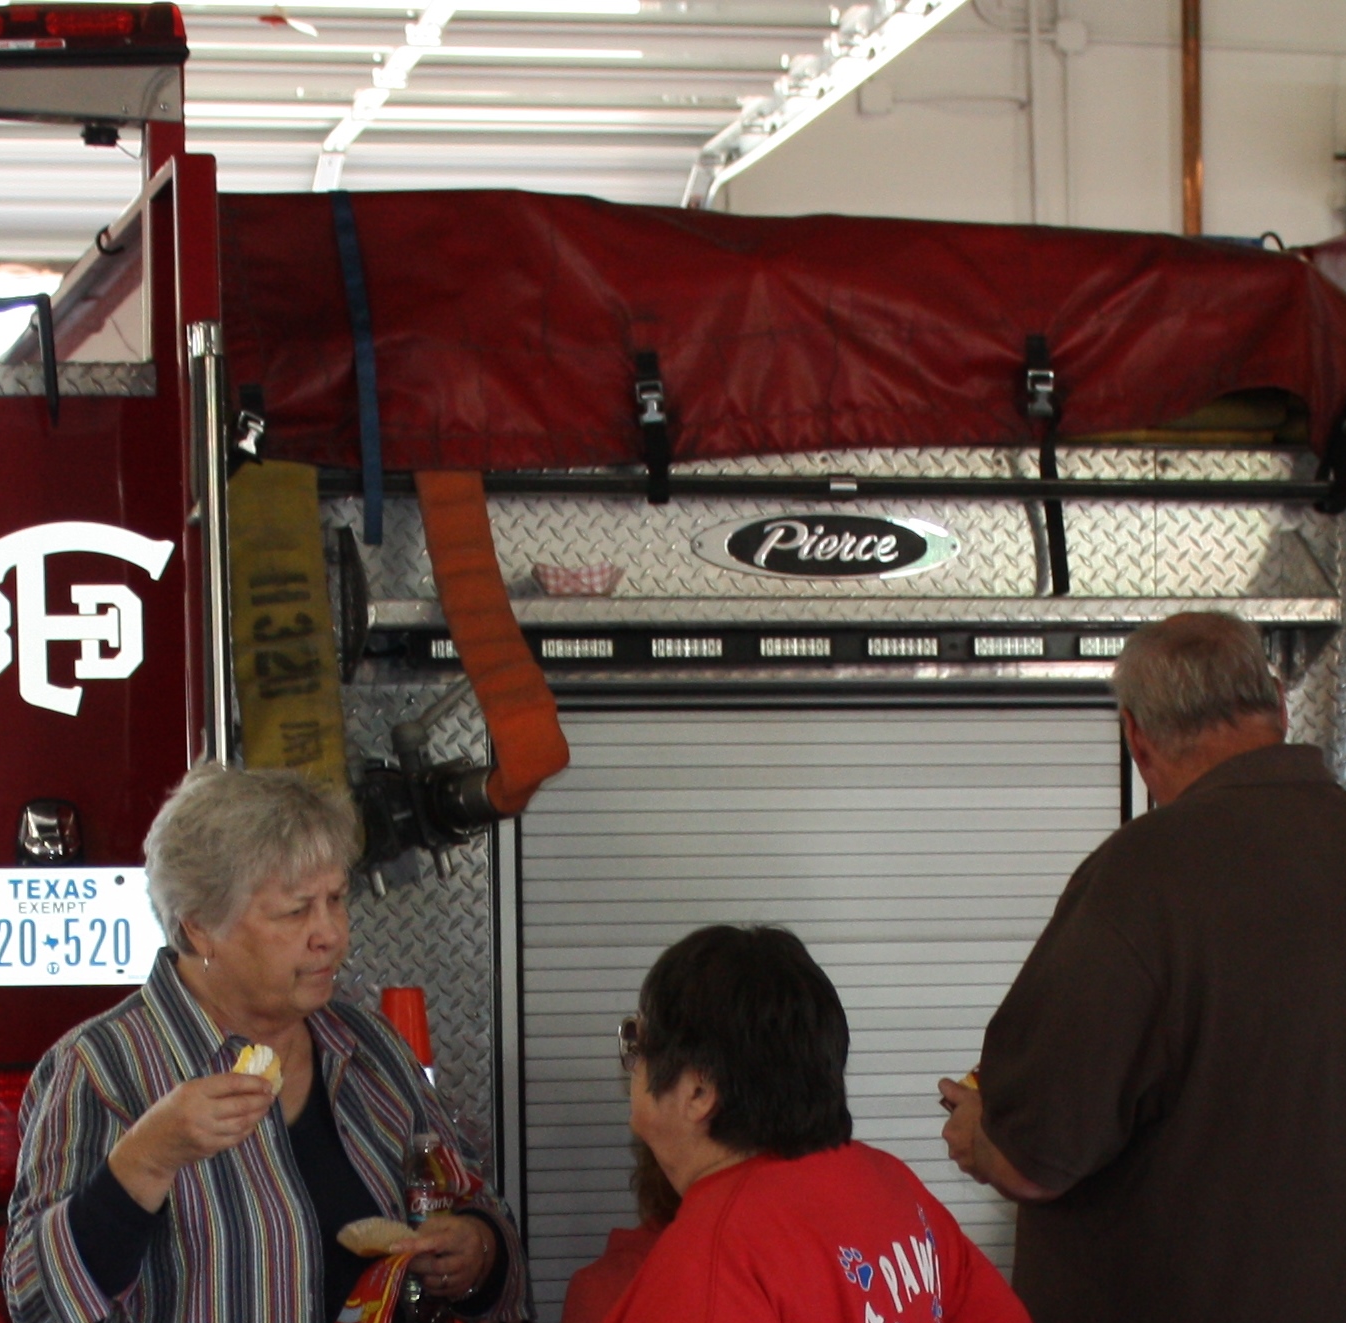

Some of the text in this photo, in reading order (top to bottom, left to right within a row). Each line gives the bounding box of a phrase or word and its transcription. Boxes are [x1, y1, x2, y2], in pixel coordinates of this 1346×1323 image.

[753, 519, 899, 568] Pierce
[8, 878, 98, 900] TEXAS
[18, 901, 87, 915] EXEMPT
[64, 918, 132, 967] 520
[878, 1234, 942, 1314] PAW
